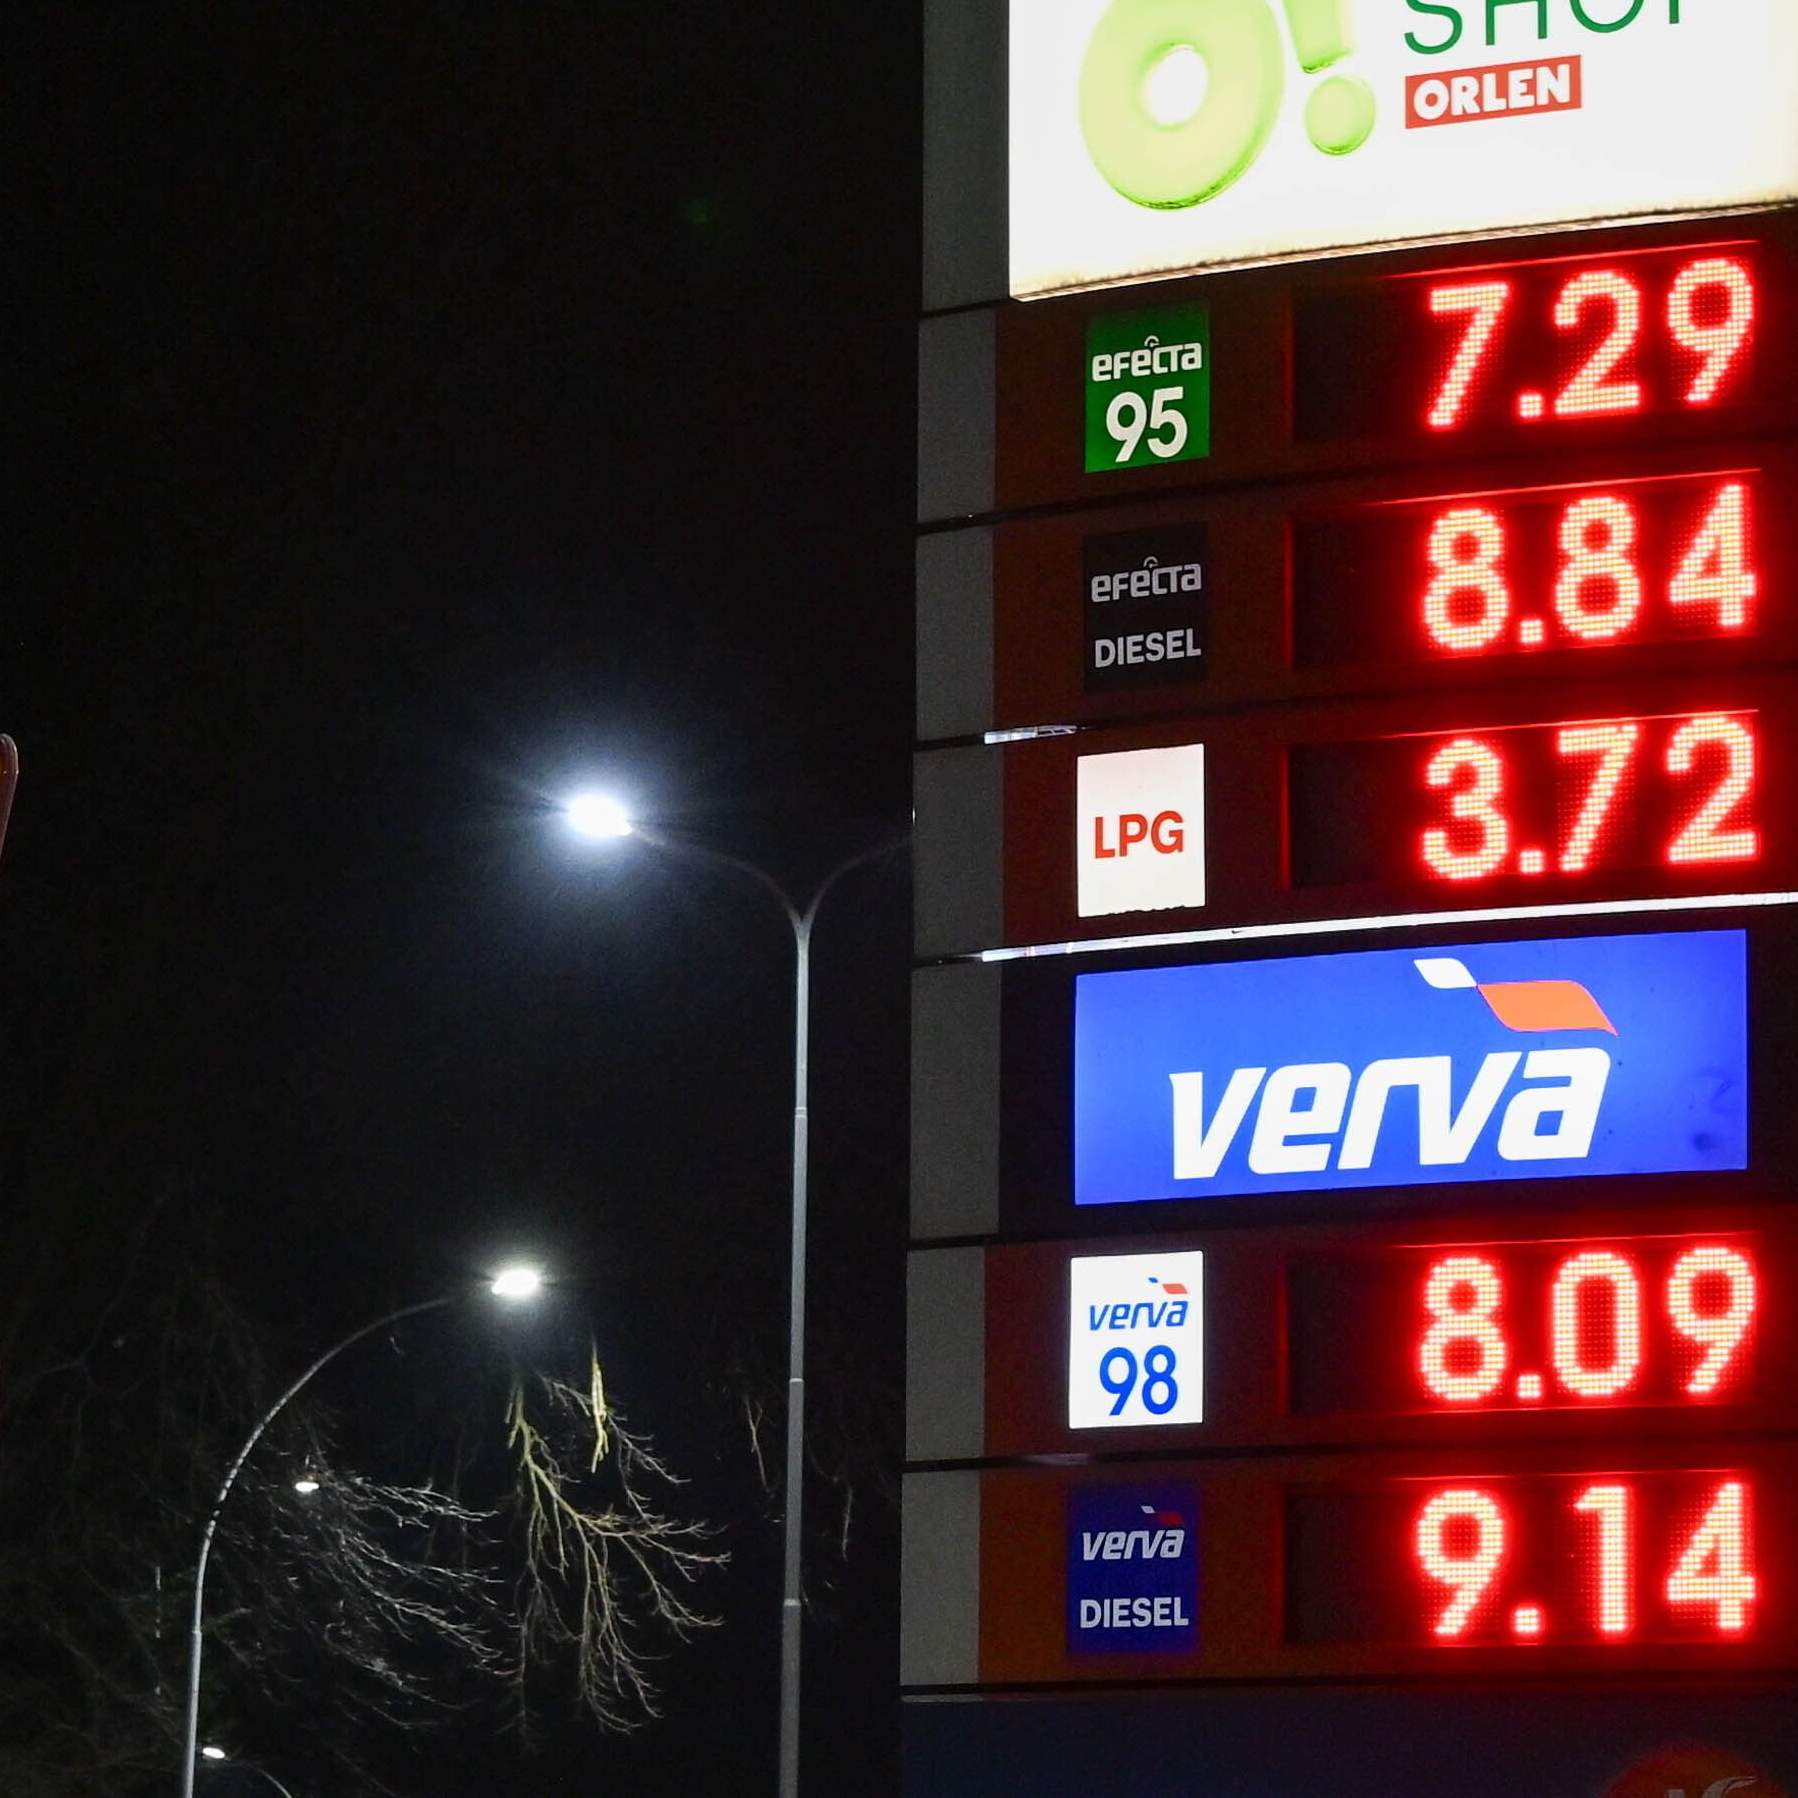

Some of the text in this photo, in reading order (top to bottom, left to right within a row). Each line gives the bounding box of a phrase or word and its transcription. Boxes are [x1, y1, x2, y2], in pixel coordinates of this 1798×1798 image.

[1413, 68, 1572, 122] ORLEN
[1428, 258, 1755, 427] 7.29
[1105, 385, 1188, 463] 95
[1423, 483, 1757, 650] 8.84
[1094, 627, 1203, 668] DIESEL
[1422, 712, 1757, 881] 3.72
[1094, 810, 1185, 859] LPG
[1168, 1047, 1612, 1181] verva
[1089, 1301, 1188, 1331] verva
[1419, 1246, 1756, 1401] 8.09
[1099, 1344, 1178, 1416] 98
[1082, 1529, 1185, 1561] verva
[1416, 1482, 1757, 1636] 9.14
[1079, 1597, 1189, 1629] DIESEL
